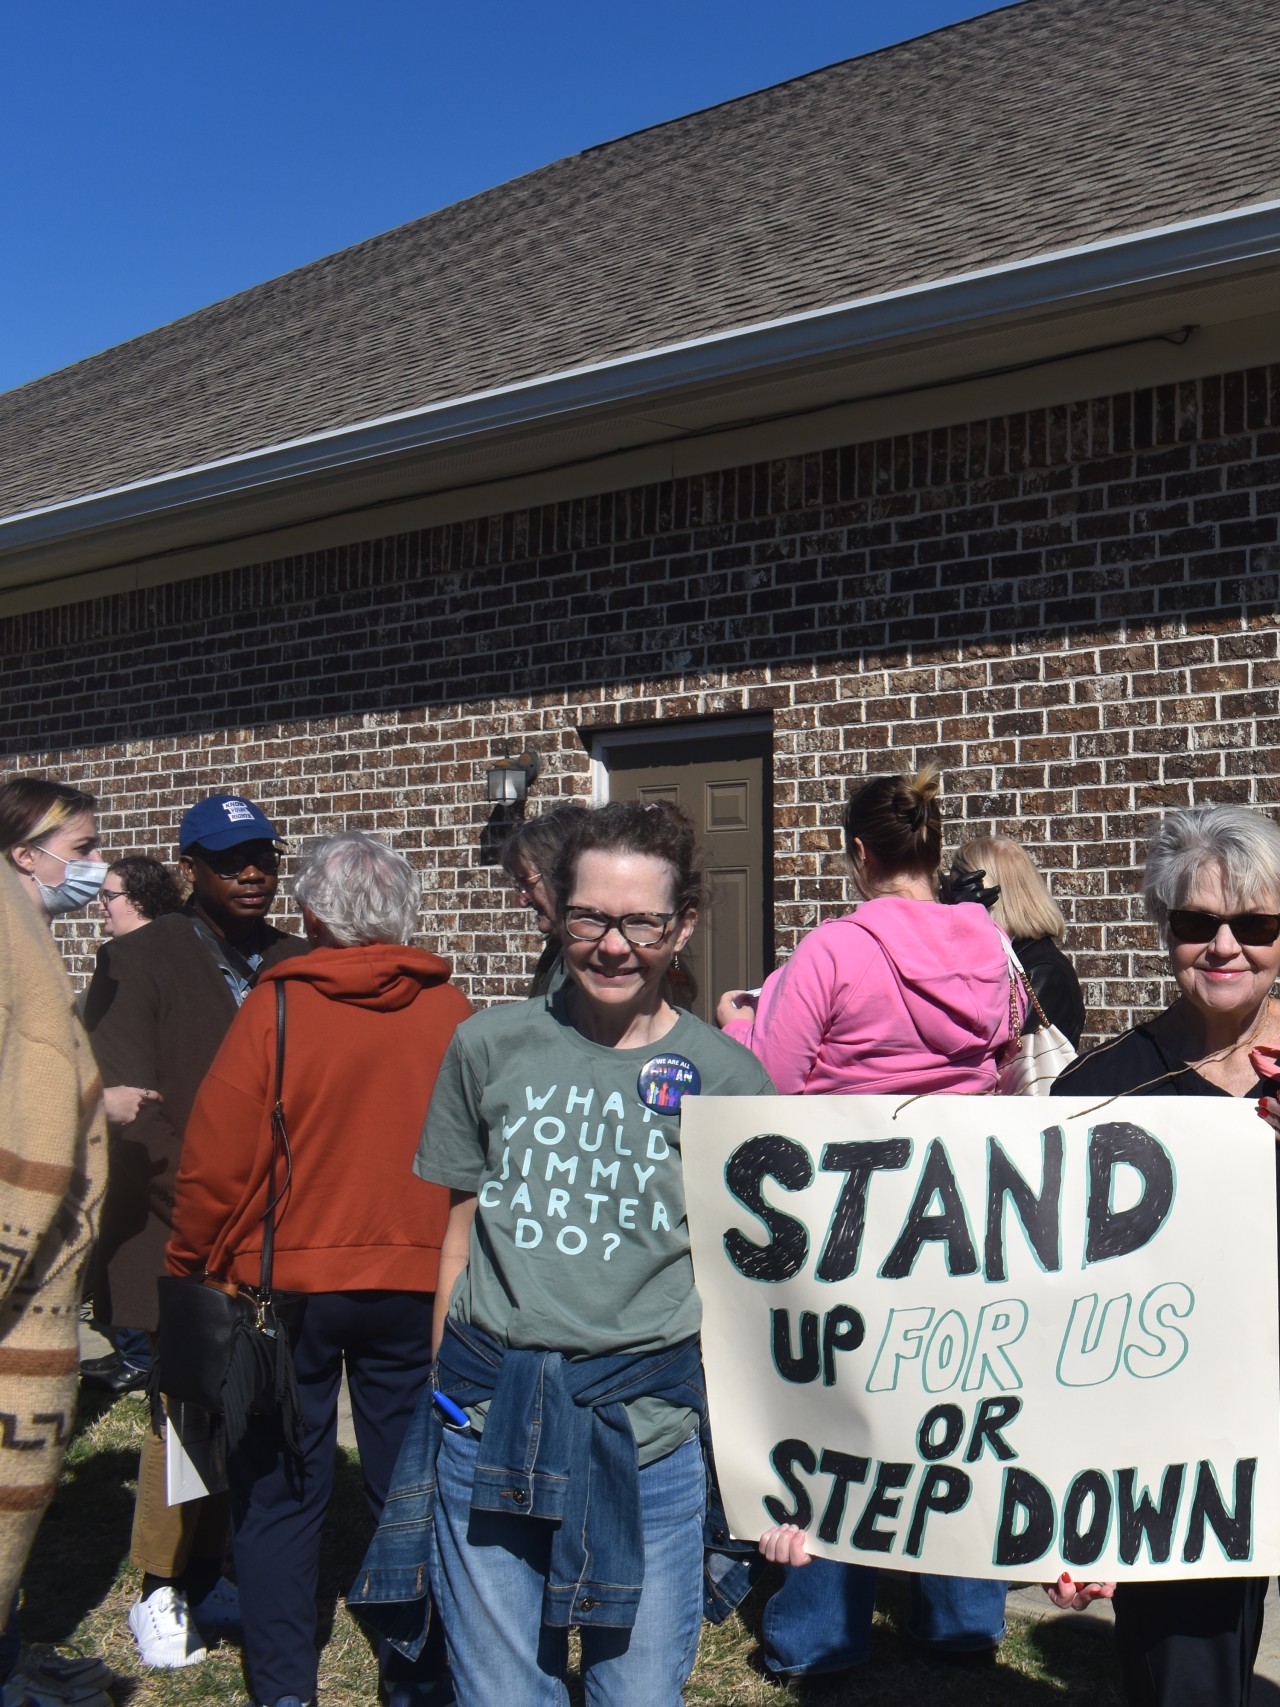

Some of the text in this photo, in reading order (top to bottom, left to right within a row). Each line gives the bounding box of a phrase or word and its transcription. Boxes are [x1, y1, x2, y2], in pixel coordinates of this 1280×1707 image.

[649, 1066, 693, 1083] HUMAN
[667, 1058, 680, 1066] ARE
[679, 1061, 691, 1070] ALL
[525, 1084, 659, 1123] WHAT
[502, 1115, 671, 1162] WOULD
[499, 1146, 656, 1194] JIMMY
[479, 1181, 671, 1232] CARTER
[723, 1121, 1178, 1284] STAND
[515, 1217, 621, 1262] DO?
[769, 1281, 1196, 1393] UP FOR US
[915, 1395, 1024, 1463] OR
[761, 1437, 1259, 1567] STEP DOWN
